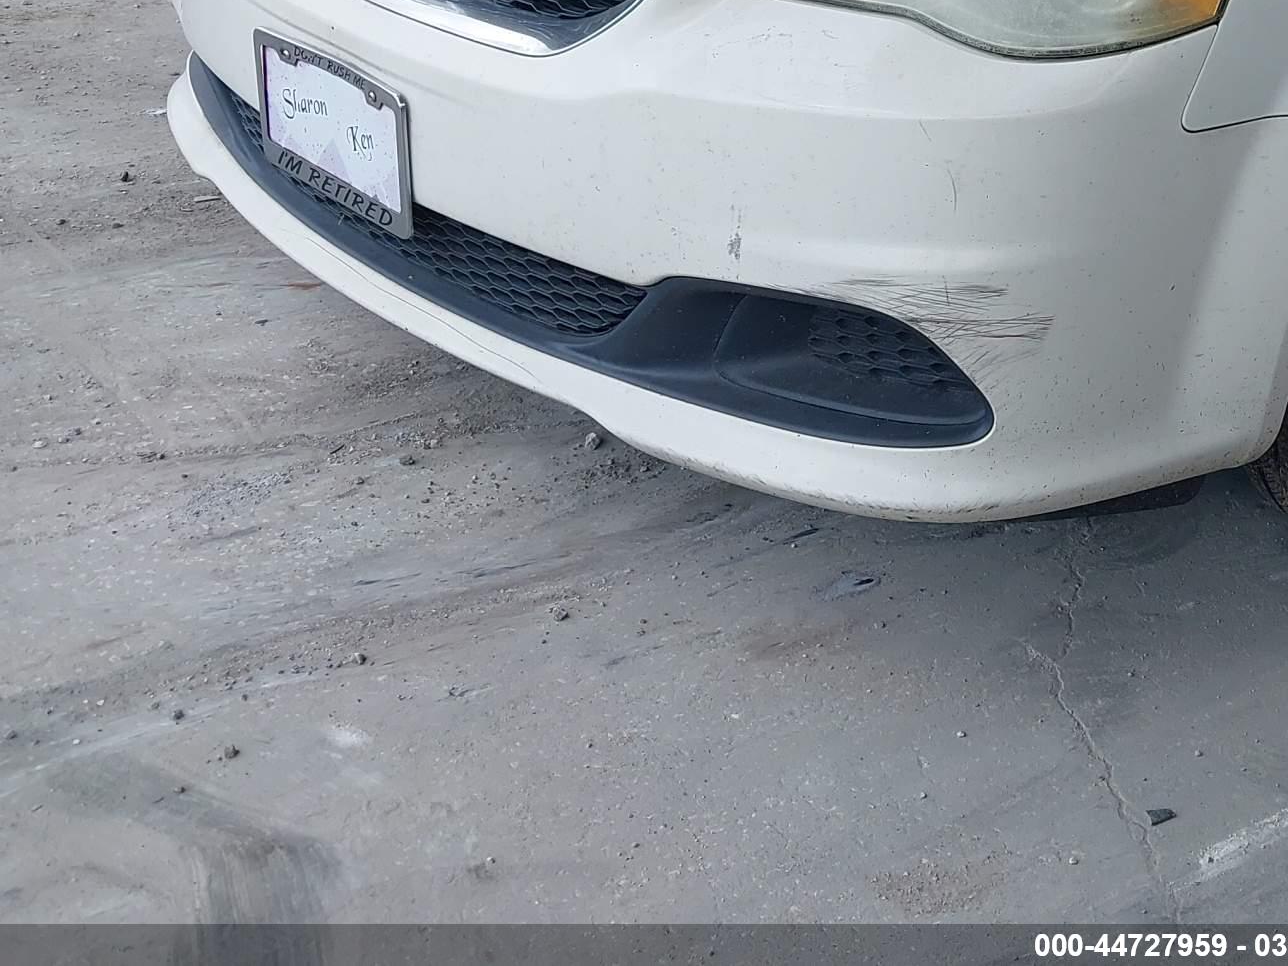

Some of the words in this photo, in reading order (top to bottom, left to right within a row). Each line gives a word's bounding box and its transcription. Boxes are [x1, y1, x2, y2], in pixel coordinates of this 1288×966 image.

[326, 61, 352, 79] RUSH
[353, 75, 366, 91] ME
[282, 88, 328, 119] Sharon
[346, 125, 374, 161] Ken
[277, 151, 302, 174] I'M
[309, 167, 393, 226] RETIRED
